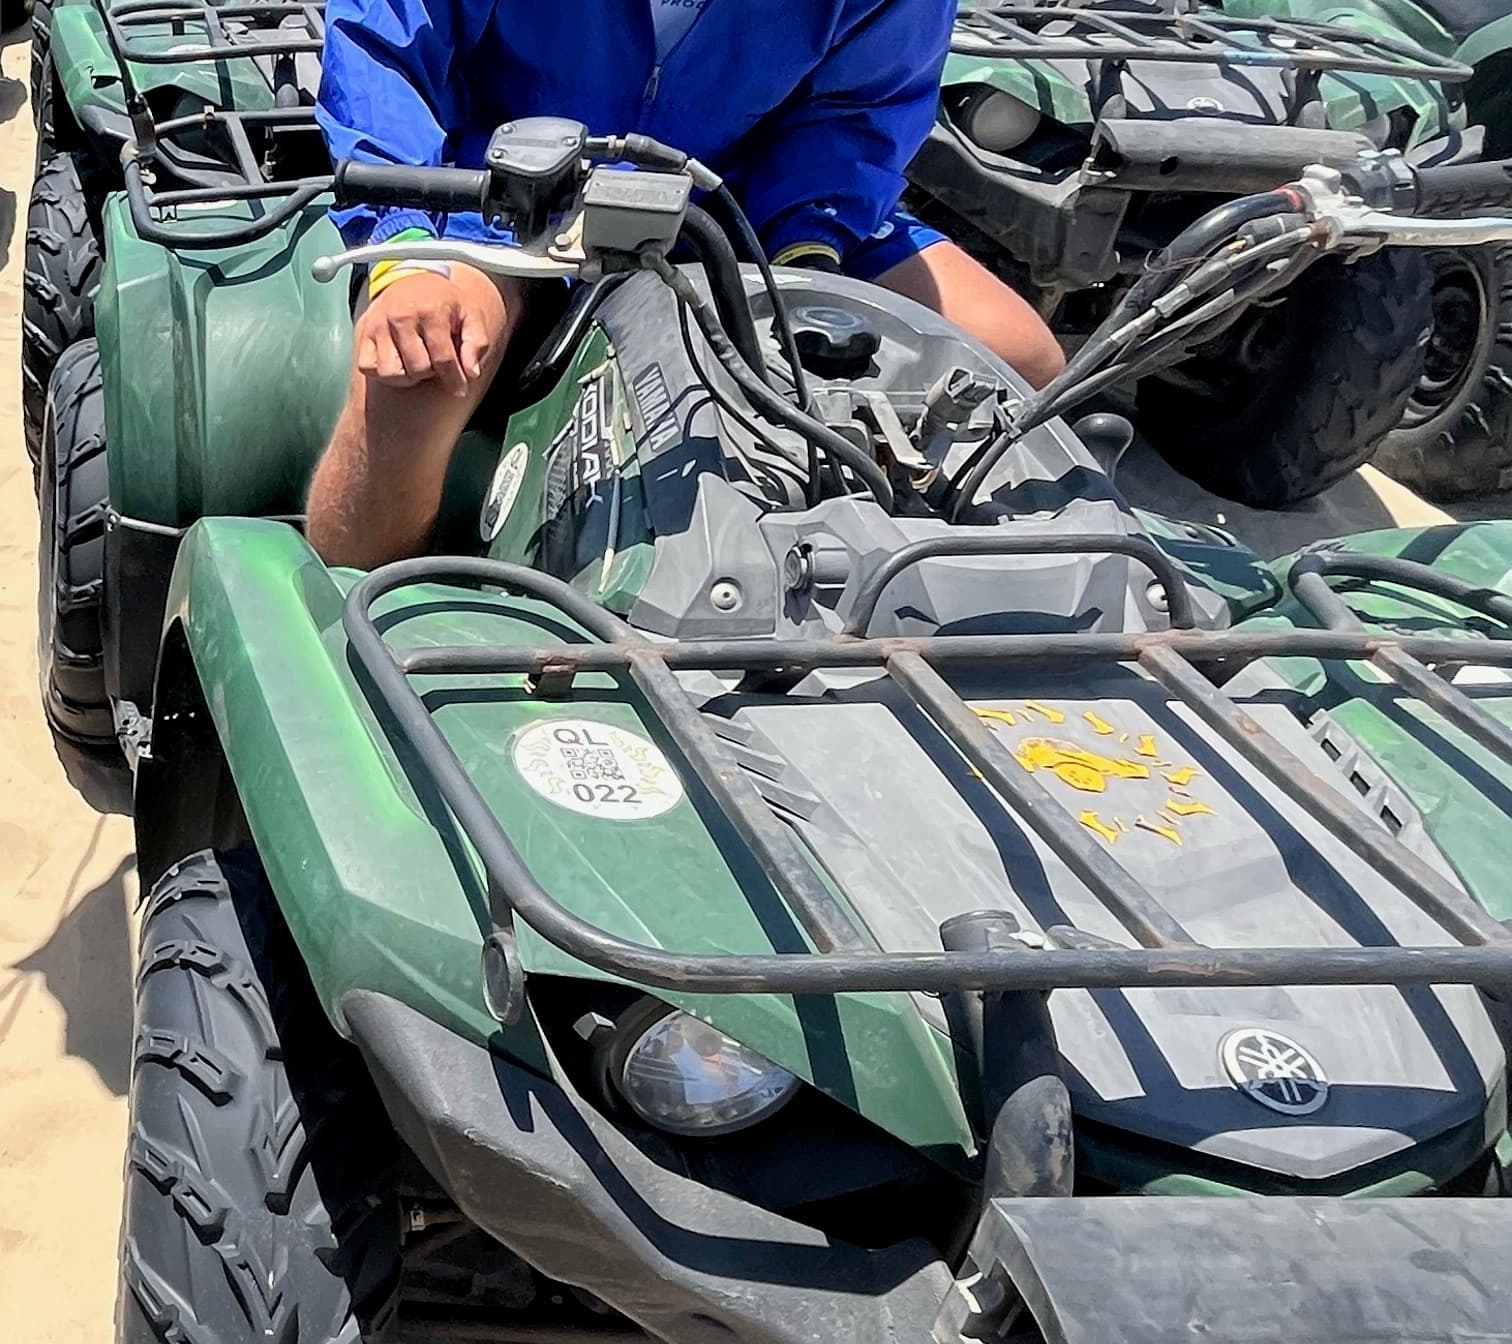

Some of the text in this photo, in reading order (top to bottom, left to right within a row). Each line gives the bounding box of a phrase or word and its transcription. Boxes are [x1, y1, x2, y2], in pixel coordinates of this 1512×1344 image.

[634, 366, 681, 452] YAMAHA
[579, 384, 605, 509] KODIAK
[553, 727, 609, 747] QL
[573, 783, 642, 804] 022
